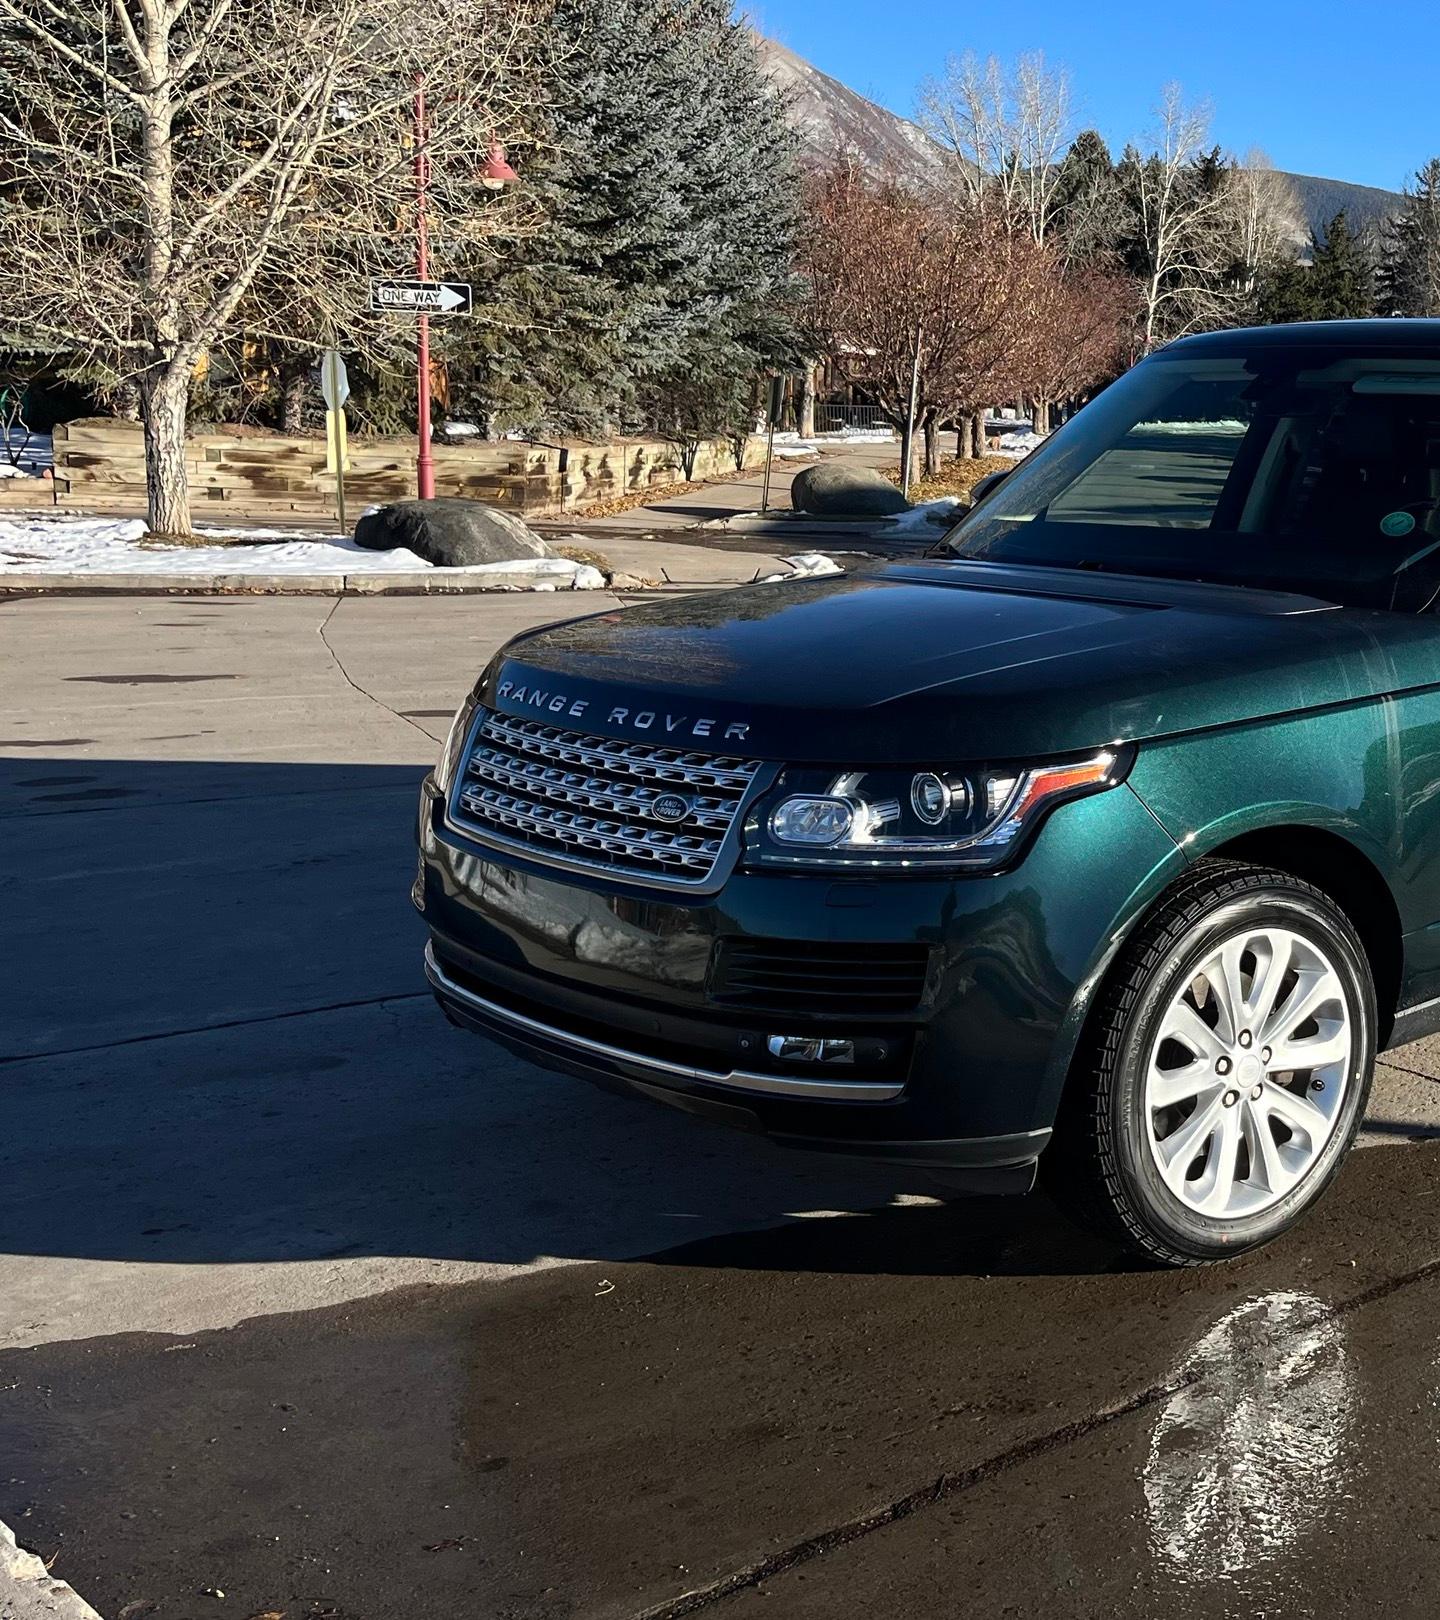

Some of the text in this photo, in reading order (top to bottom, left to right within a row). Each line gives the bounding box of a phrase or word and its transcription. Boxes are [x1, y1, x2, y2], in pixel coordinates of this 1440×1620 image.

[382, 289, 441, 303] ONE WAY
[497, 680, 750, 740] RANGE ROVER
[660, 799, 678, 808] LAND
[659, 807, 681, 817] ROVER
